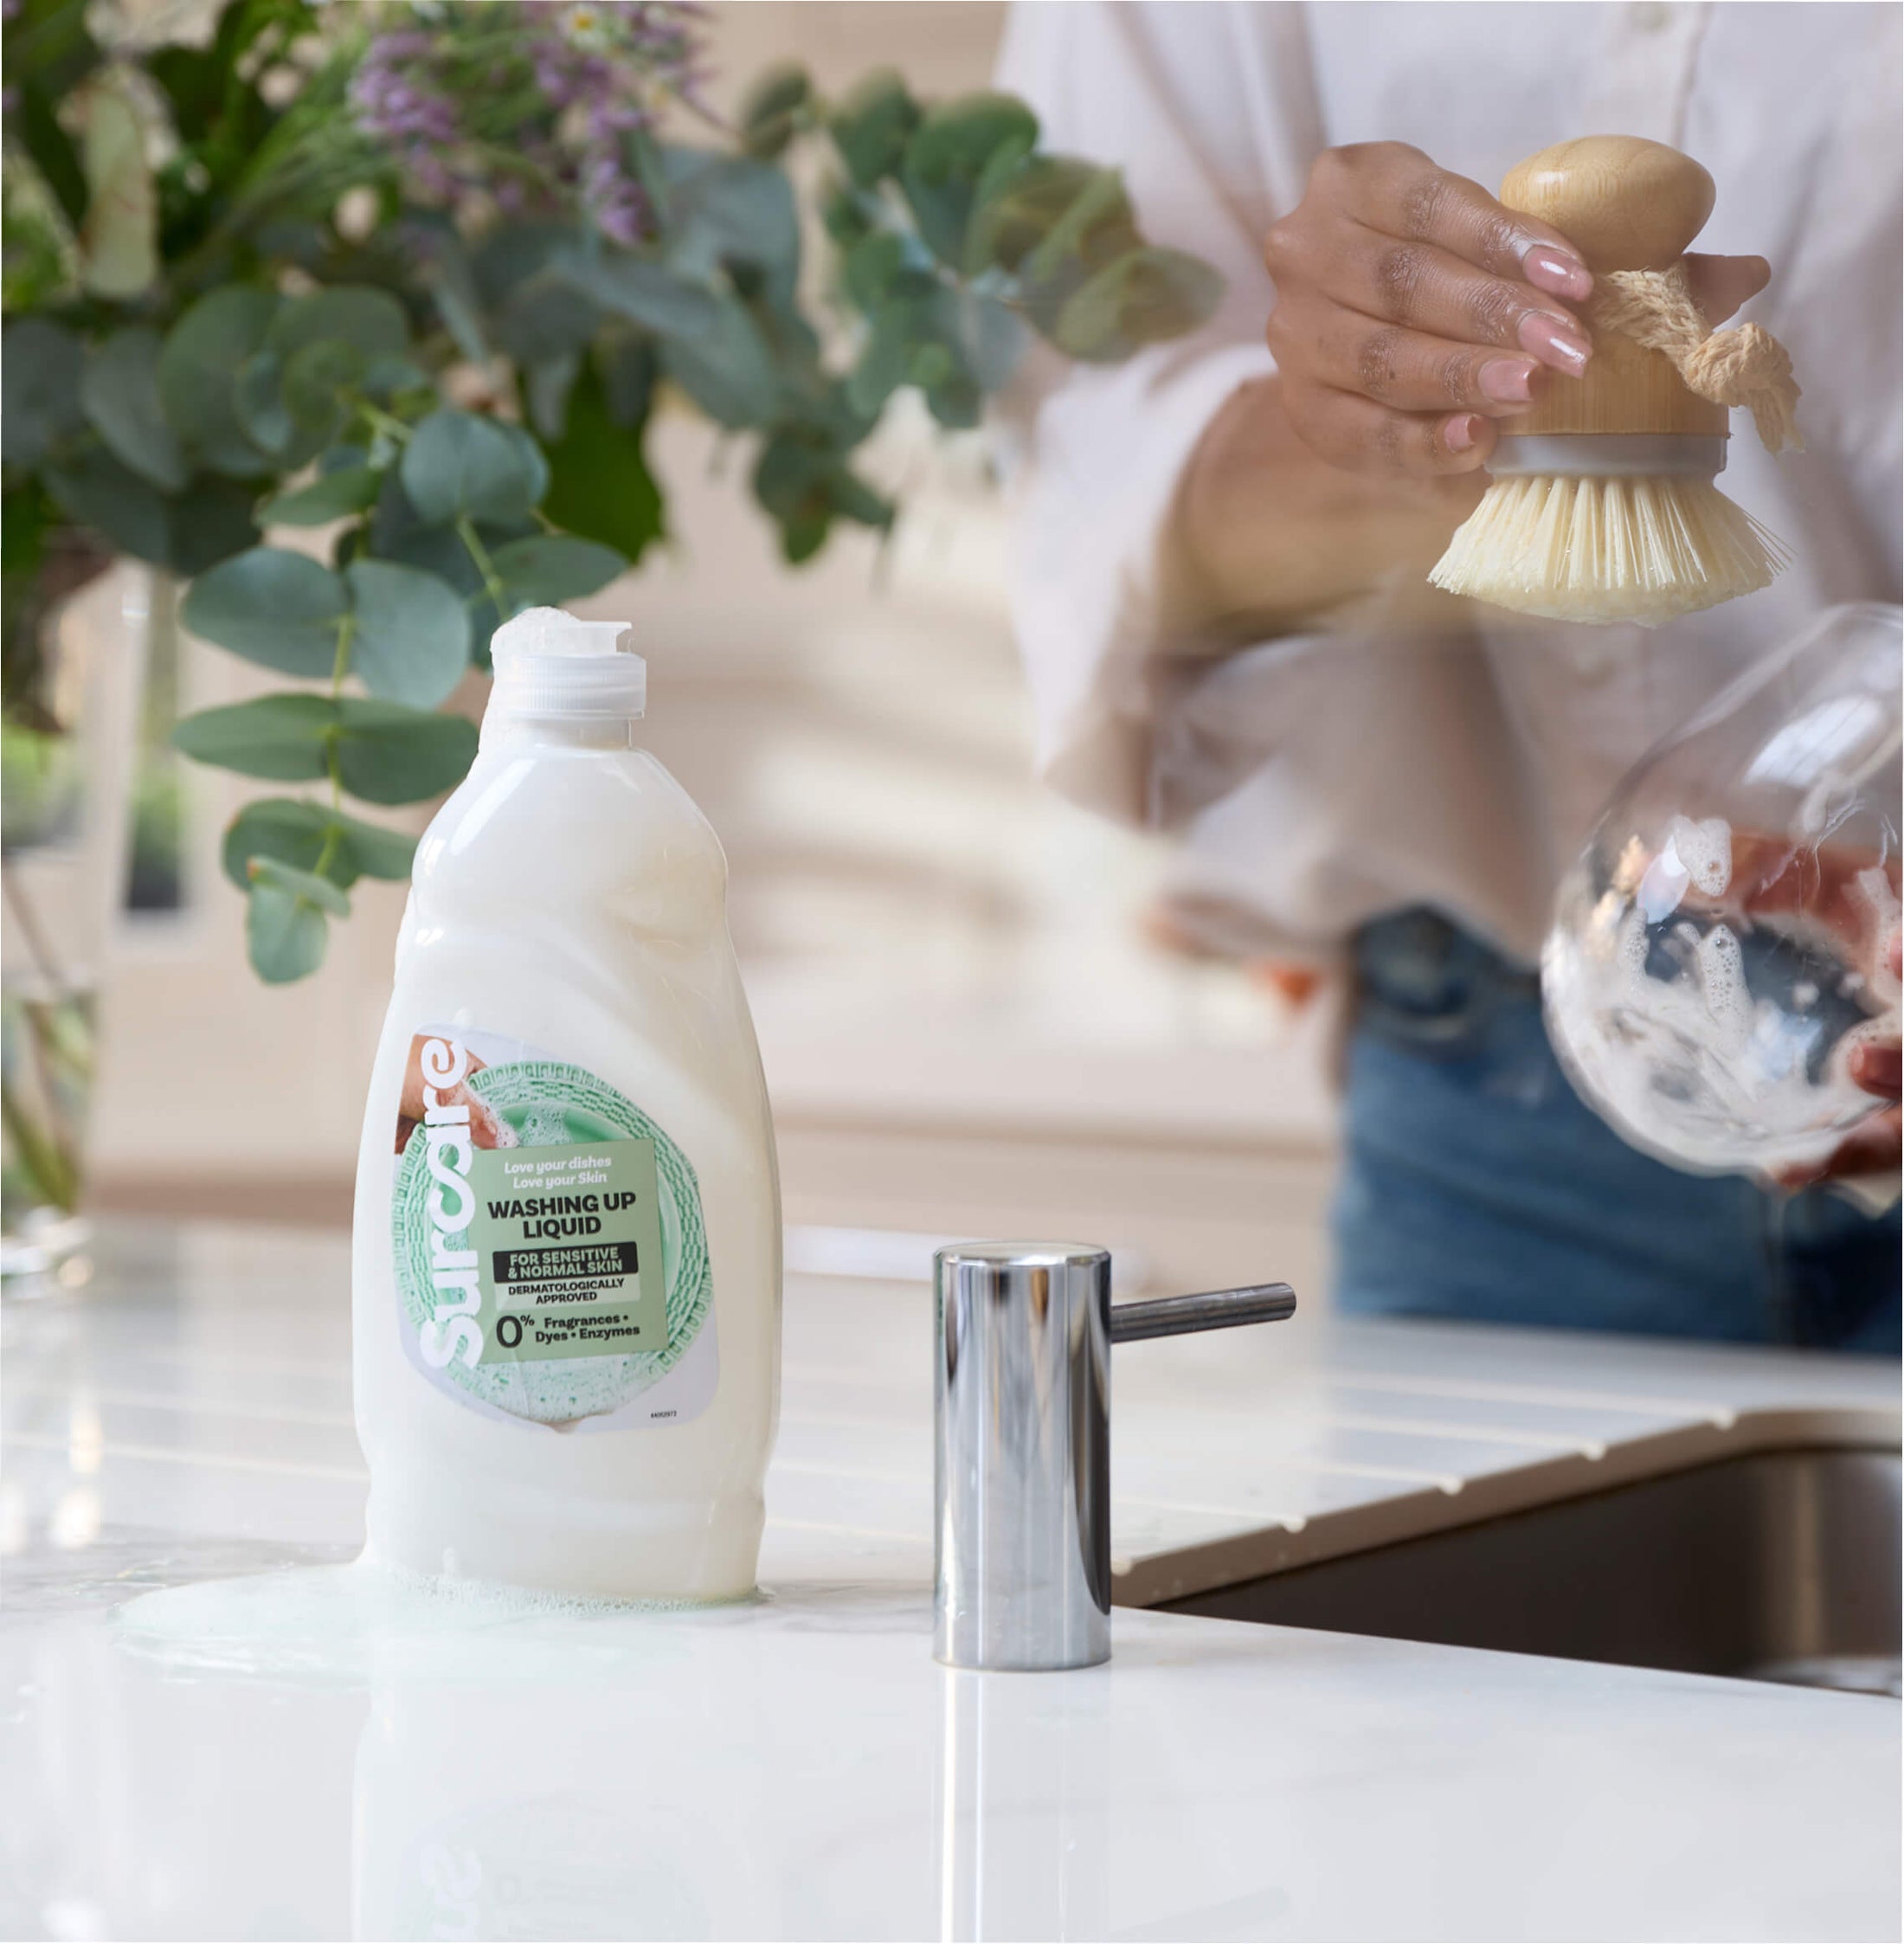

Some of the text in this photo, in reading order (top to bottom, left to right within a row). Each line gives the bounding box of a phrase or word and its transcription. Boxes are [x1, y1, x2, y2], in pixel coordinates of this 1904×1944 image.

[505, 1155, 611, 1175] Love your dishes
[513, 1171, 608, 1190] Love your Skin
[487, 1192, 636, 1219] WASHING UP
[523, 1216, 601, 1239] LIQUID
[510, 1246, 619, 1266] FOR SENSITIVE
[507, 1259, 623, 1279] & NORMAL SKIN
[508, 1278, 625, 1296] DERMATOLOGICALLY
[536, 1291, 598, 1305] APPROVED
[544, 1316, 620, 1330] Fragrances
[535, 1325, 640, 1345] Dyes Enzymes
